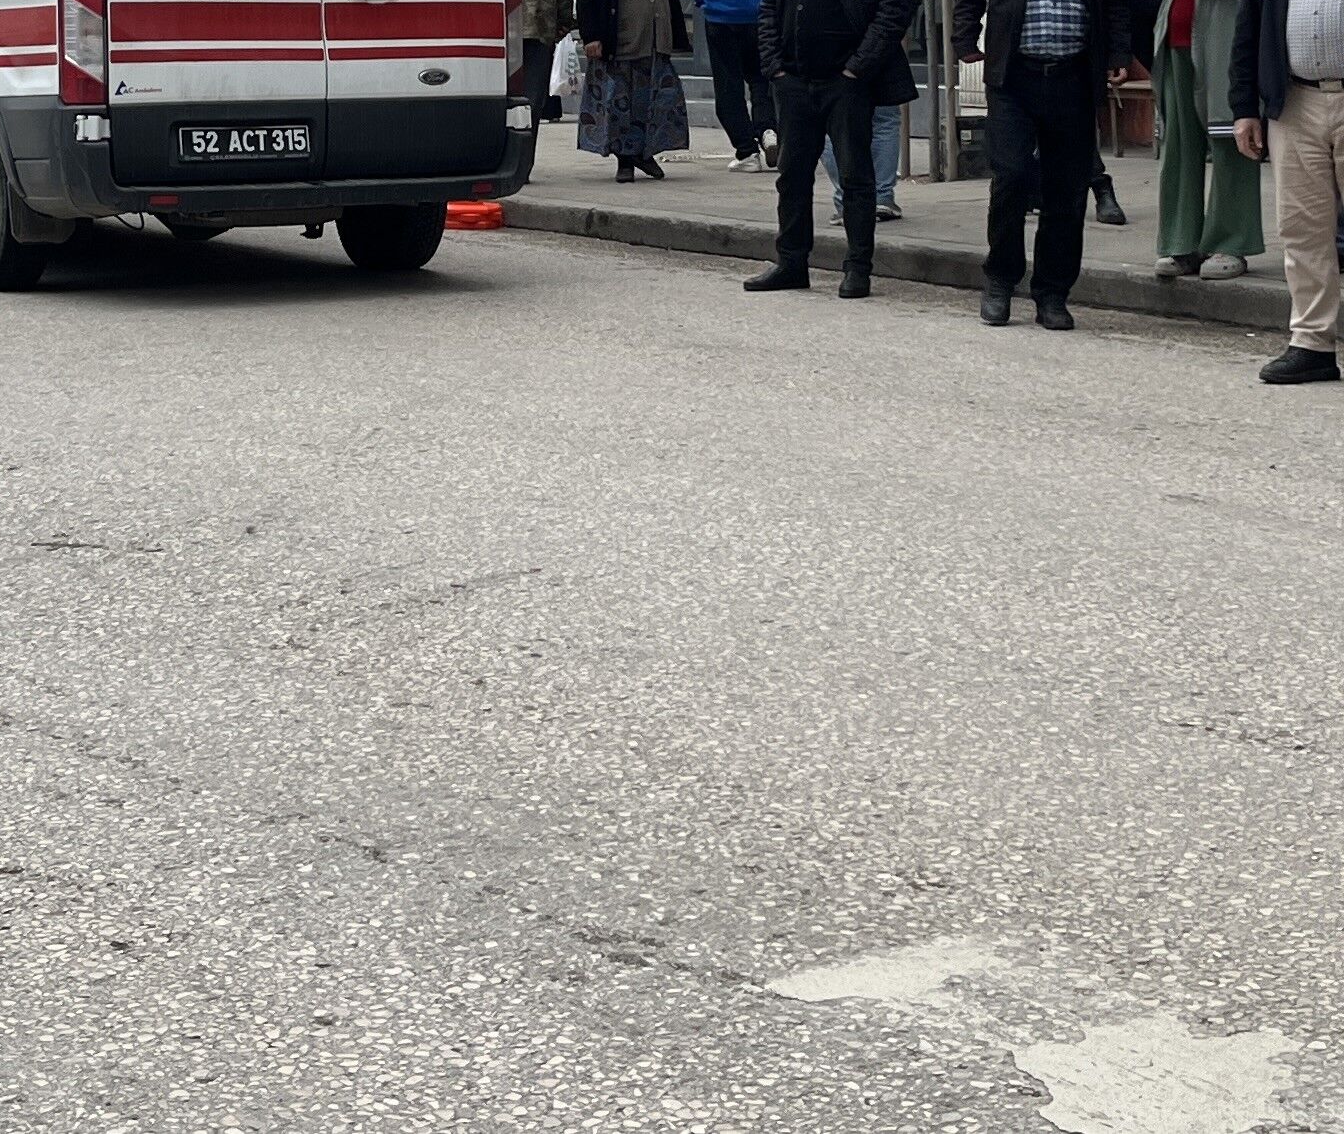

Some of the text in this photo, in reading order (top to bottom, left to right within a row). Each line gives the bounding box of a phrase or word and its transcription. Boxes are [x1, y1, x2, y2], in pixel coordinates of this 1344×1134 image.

[192, 129, 306, 153] 52 ACT 315
